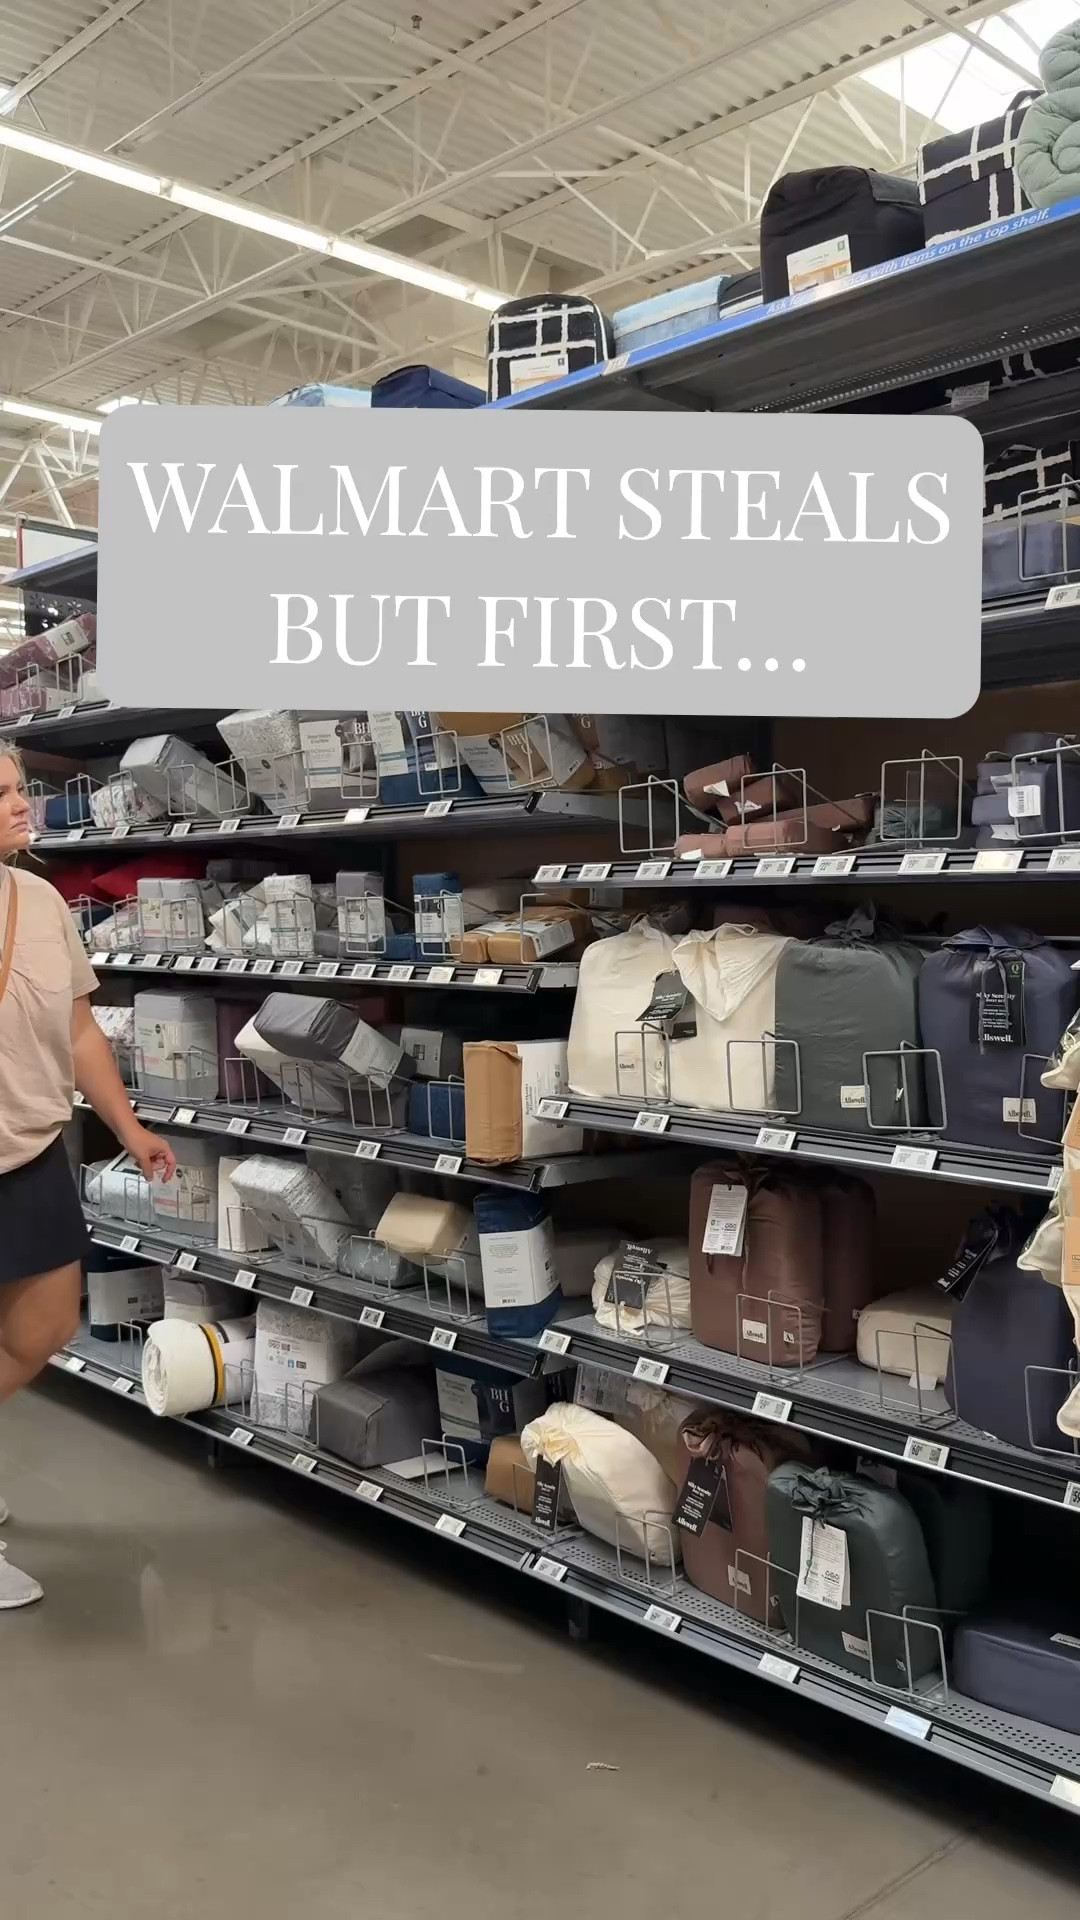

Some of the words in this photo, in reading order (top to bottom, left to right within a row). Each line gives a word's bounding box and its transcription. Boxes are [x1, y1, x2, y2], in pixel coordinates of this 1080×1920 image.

[870, 260, 898, 277] with
[900, 249, 937, 268] items
[938, 242, 957, 255] on
[959, 233, 982, 248] the
[984, 223, 1010, 239] top
[1011, 206, 1050, 228] shelf.
[767, 300, 788, 315] Ask
[418, 715, 428, 729] G
[978, 1033, 1014, 1042] llswell.
[499, 1401, 510, 1413] G
